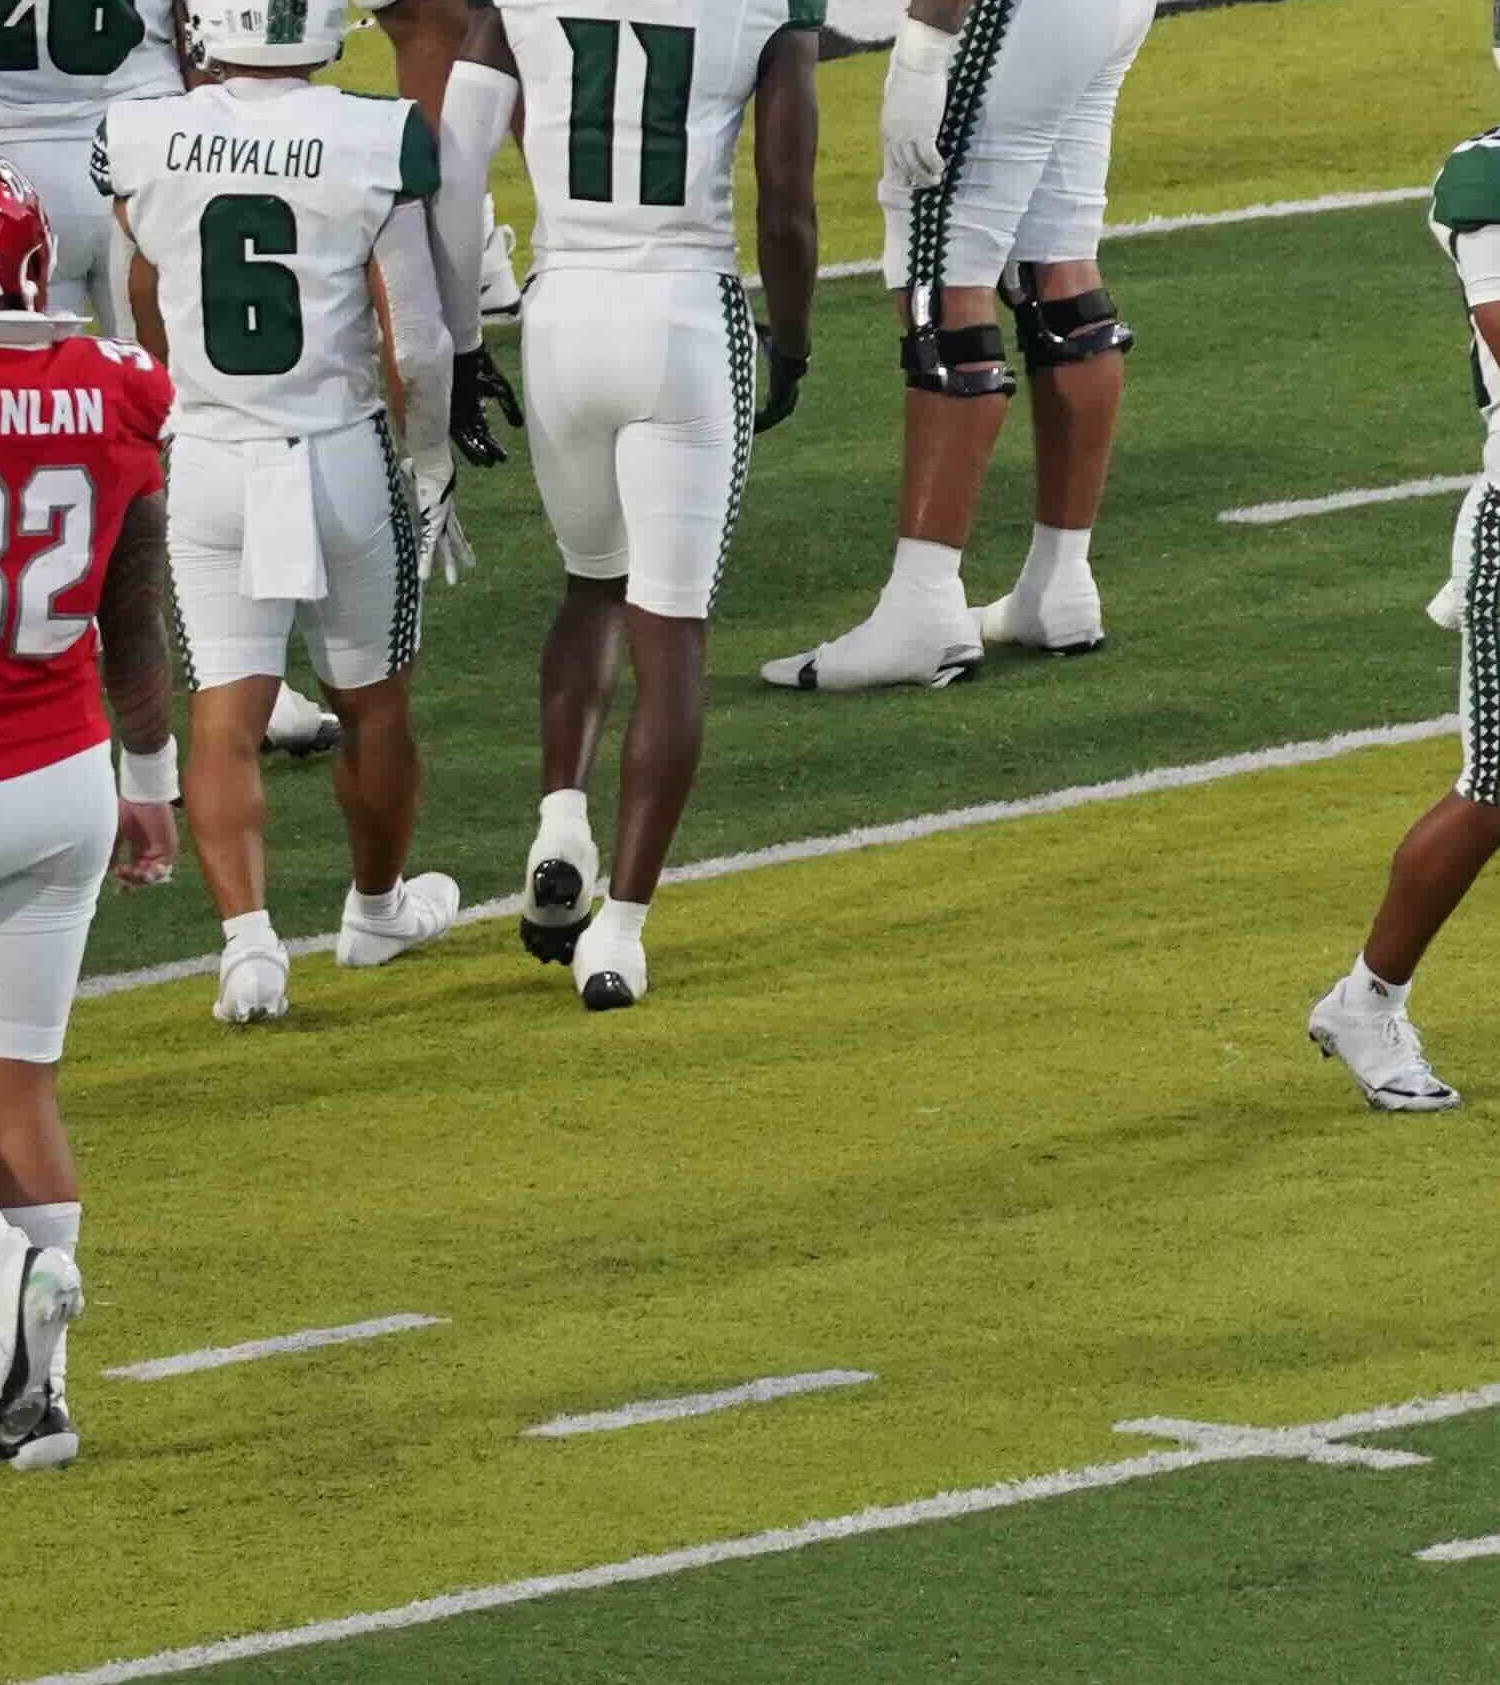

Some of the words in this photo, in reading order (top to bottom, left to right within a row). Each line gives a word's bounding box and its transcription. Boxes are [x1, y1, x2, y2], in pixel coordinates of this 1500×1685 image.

[165, 131, 325, 179] CARVALHO
[556, 16, 696, 206] 11
[200, 193, 304, 376] 6
